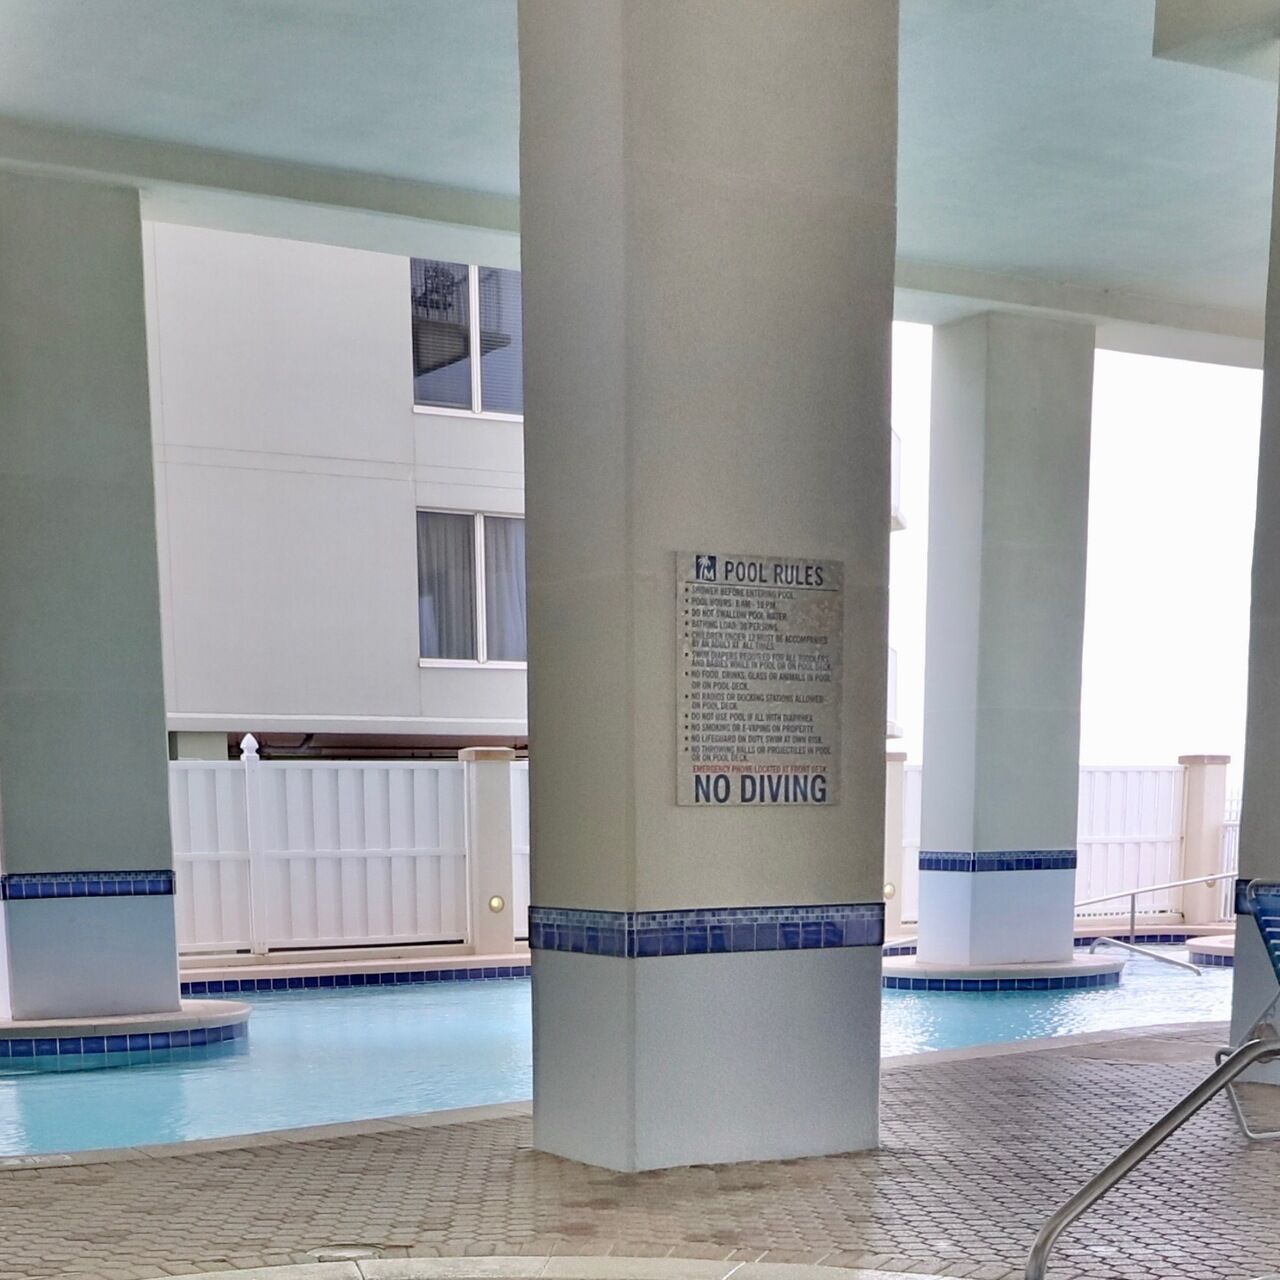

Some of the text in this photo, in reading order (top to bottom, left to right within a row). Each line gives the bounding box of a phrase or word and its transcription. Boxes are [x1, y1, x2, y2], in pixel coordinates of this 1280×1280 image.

[724, 561, 824, 586] POOL RULES
[721, 588, 744, 597] BEFORE
[741, 600, 750, 608] AM
[692, 609, 700, 617] DO
[703, 609, 714, 617] NOT
[716, 610, 746, 619] SWALLOW
[749, 611, 764, 619] POOL
[692, 620, 717, 628] BATHING
[760, 661, 774, 669] POOL
[748, 672, 767, 680] GLASS
[779, 673, 805, 681] ANIMALS
[691, 692, 700, 700] NO
[766, 694, 793, 702] STATIONS
[795, 695, 823, 703] ALLOWED
[715, 713, 727, 721] USE
[816, 747, 831, 755] POOL
[691, 754, 700, 762] OR
[702, 754, 711, 762] ON
[713, 754, 728, 762] POOL
[695, 774, 827, 803] NO DIVING
